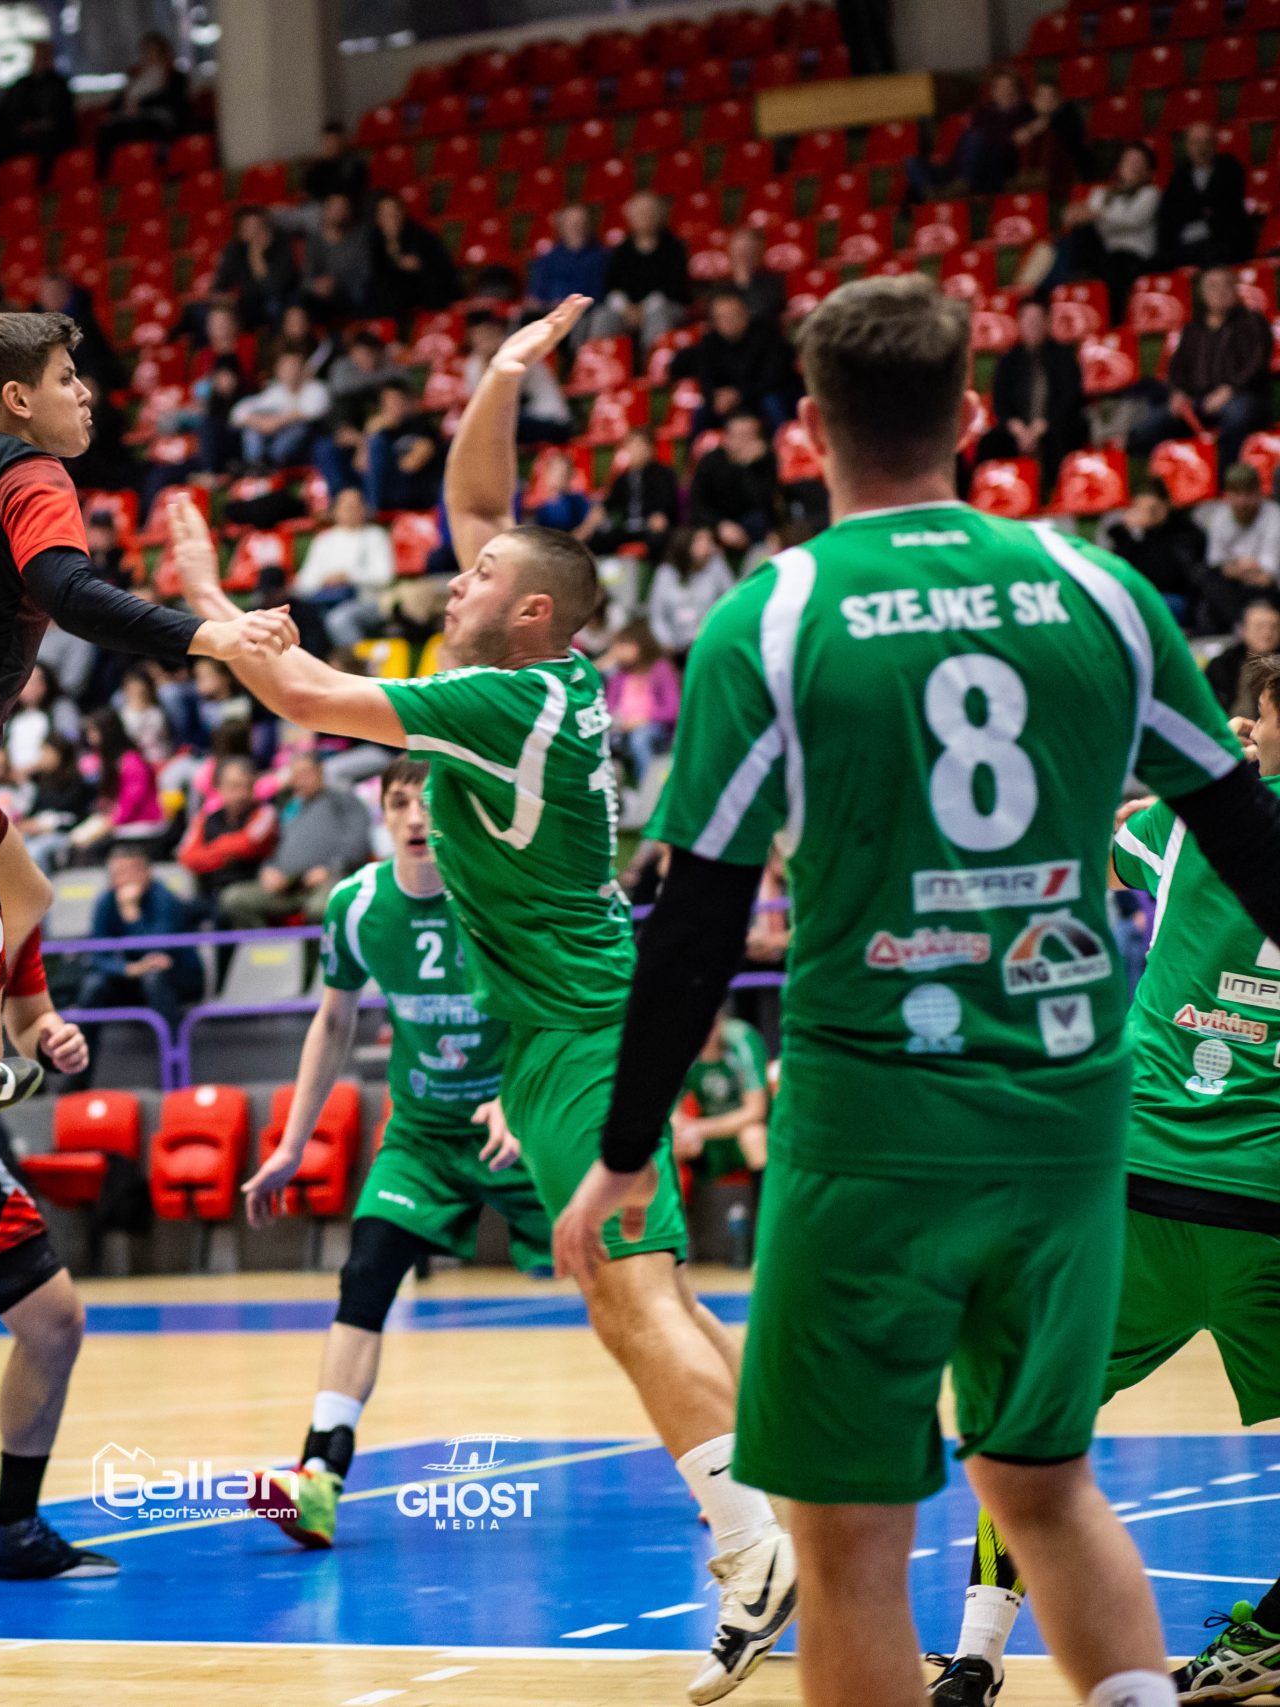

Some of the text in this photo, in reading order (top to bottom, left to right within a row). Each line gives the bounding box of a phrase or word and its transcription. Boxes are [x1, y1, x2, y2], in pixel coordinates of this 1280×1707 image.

[839, 580, 1071, 640] SZEJKE SK
[923, 652, 1039, 852] 8
[415, 931, 446, 980] 2
[1008, 961, 1051, 988] ING
[1224, 976, 1280, 1001] IMP
